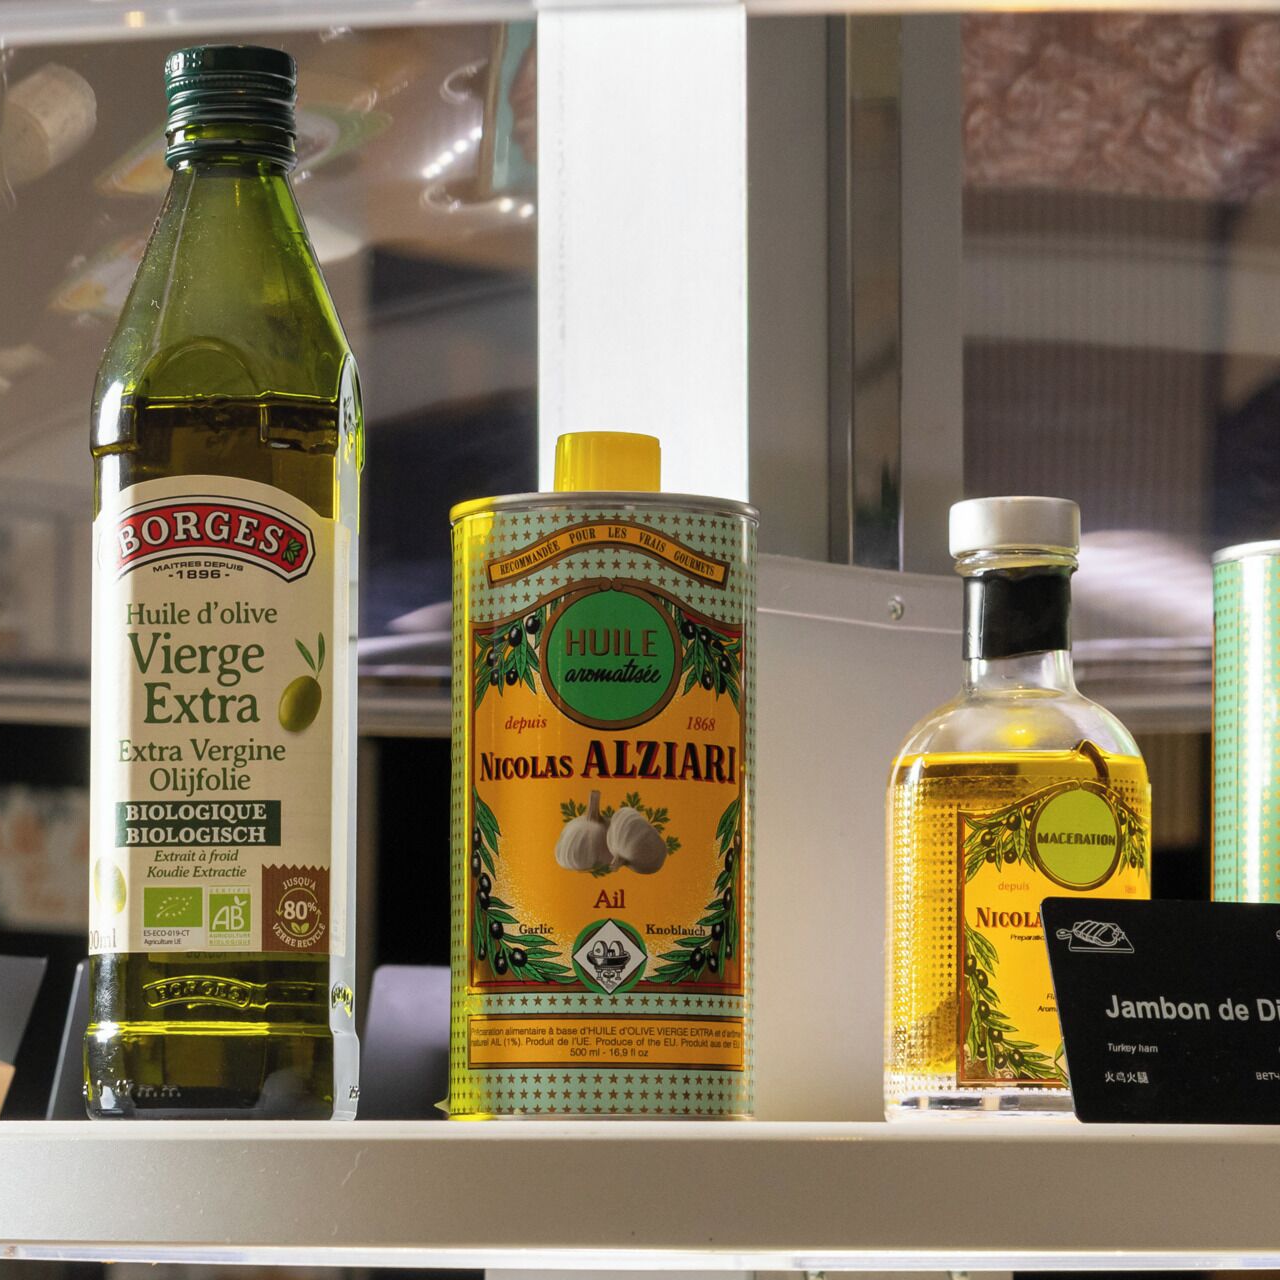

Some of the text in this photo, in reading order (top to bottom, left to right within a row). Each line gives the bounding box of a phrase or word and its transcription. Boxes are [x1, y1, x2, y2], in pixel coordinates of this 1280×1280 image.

[120, 510, 284, 558] BORGES
[500, 527, 715, 576] RECOMMANDÉE POUR LES VRAIS GOURMETS
[153, 561, 244, 573] MAITRES DEPUIS
[127, 603, 190, 624] Huile
[566, 628, 657, 657] HUILE
[128, 632, 264, 687] Vierge
[565, 659, 662, 684] aromatisée
[143, 682, 260, 724] Extra
[504, 715, 716, 734] depuis 1868
[119, 738, 286, 768] Extra Vergine
[581, 739, 736, 785] ALZIARI
[149, 768, 250, 797] Olijfolie
[125, 803, 267, 823] BIOLOGIQUE
[126, 826, 266, 844] BIOLOGISCH
[1037, 832, 1115, 846] MACERATION
[154, 849, 239, 864] Extrait à froid
[147, 866, 247, 878] Koudie Extractie
[998, 882, 1029, 892] depuis
[593, 889, 626, 909] Ail
[212, 906, 244, 930] AB
[284, 900, 317, 920] 80%
[272, 923, 297, 947] VERRE
[518, 924, 554, 936] Garlic
[645, 924, 706, 938] Knoblauch
[144, 938, 173, 946] Agriculture
[1106, 994, 1211, 1021] Jambon
[1219, 998, 1250, 1022] de
[556, 1027, 578, 1035] base
[580, 1027, 616, 1035] d'HUILE
[619, 1026, 654, 1036] d'OLIVE
[657, 1027, 688, 1036] VIERGE
[690, 1028, 713, 1037] EXTRA
[525, 1037, 554, 1046] Produit
[557, 1037, 569, 1046] de
[595, 1037, 633, 1046] Produce
[636, 1038, 645, 1046] of
[647, 1038, 661, 1046] the
[681, 1038, 708, 1047] Produkt
[570, 1048, 587, 1056] 500
[588, 1048, 600, 1056] ml
[609, 1048, 628, 1056] 16.9
[630, 1048, 636, 1056] fl
[1108, 1042, 1159, 1055] Turkey ham
